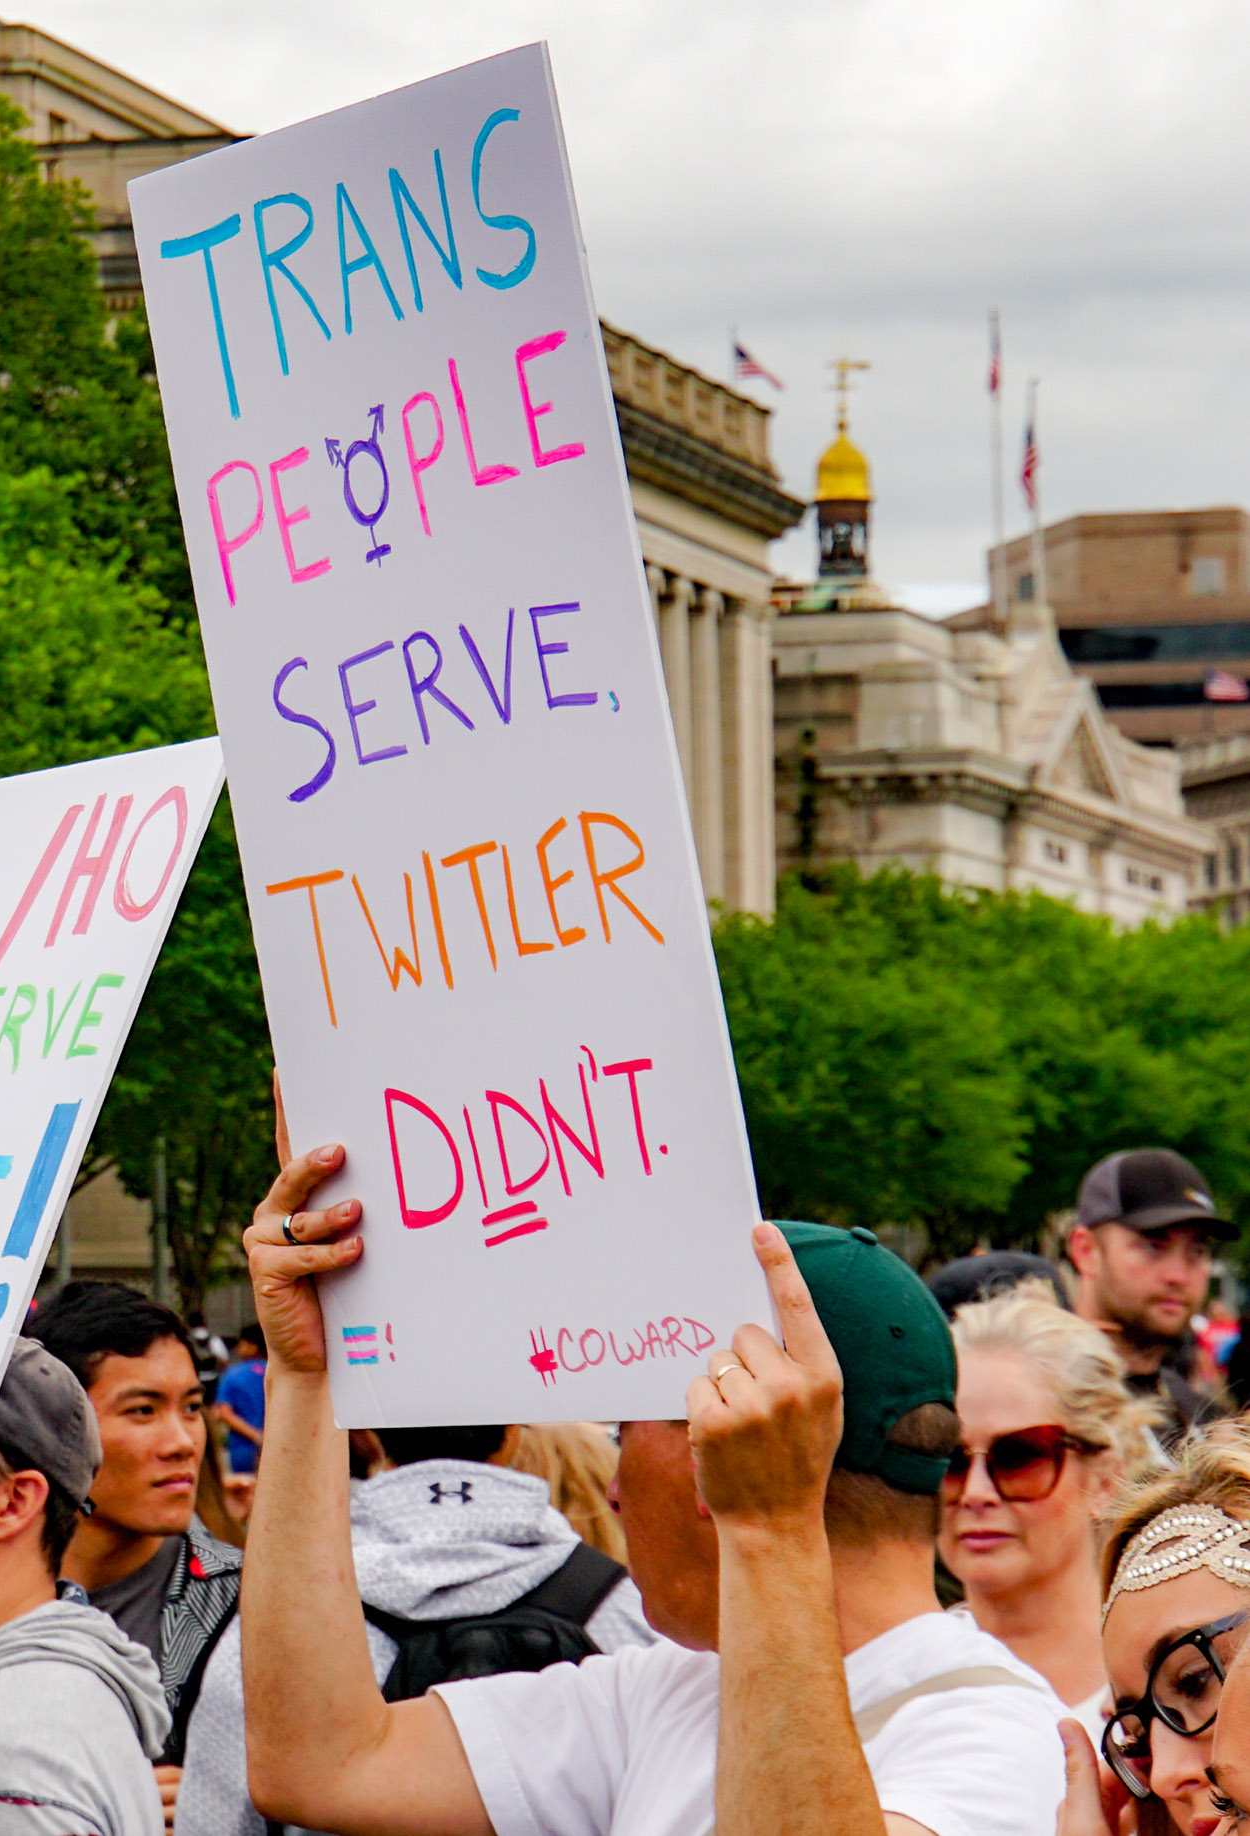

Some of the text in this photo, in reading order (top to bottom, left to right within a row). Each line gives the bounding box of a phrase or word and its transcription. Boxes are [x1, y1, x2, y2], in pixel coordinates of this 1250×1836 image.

[161, 107, 537, 420] TRANS
[206, 329, 586, 608] PEOPLE
[272, 601, 621, 803] SERVE,
[265, 810, 665, 1029] TWITLER
[383, 1044, 670, 1230] DIDN'T.
[528, 1315, 717, 1389] #COWARD
